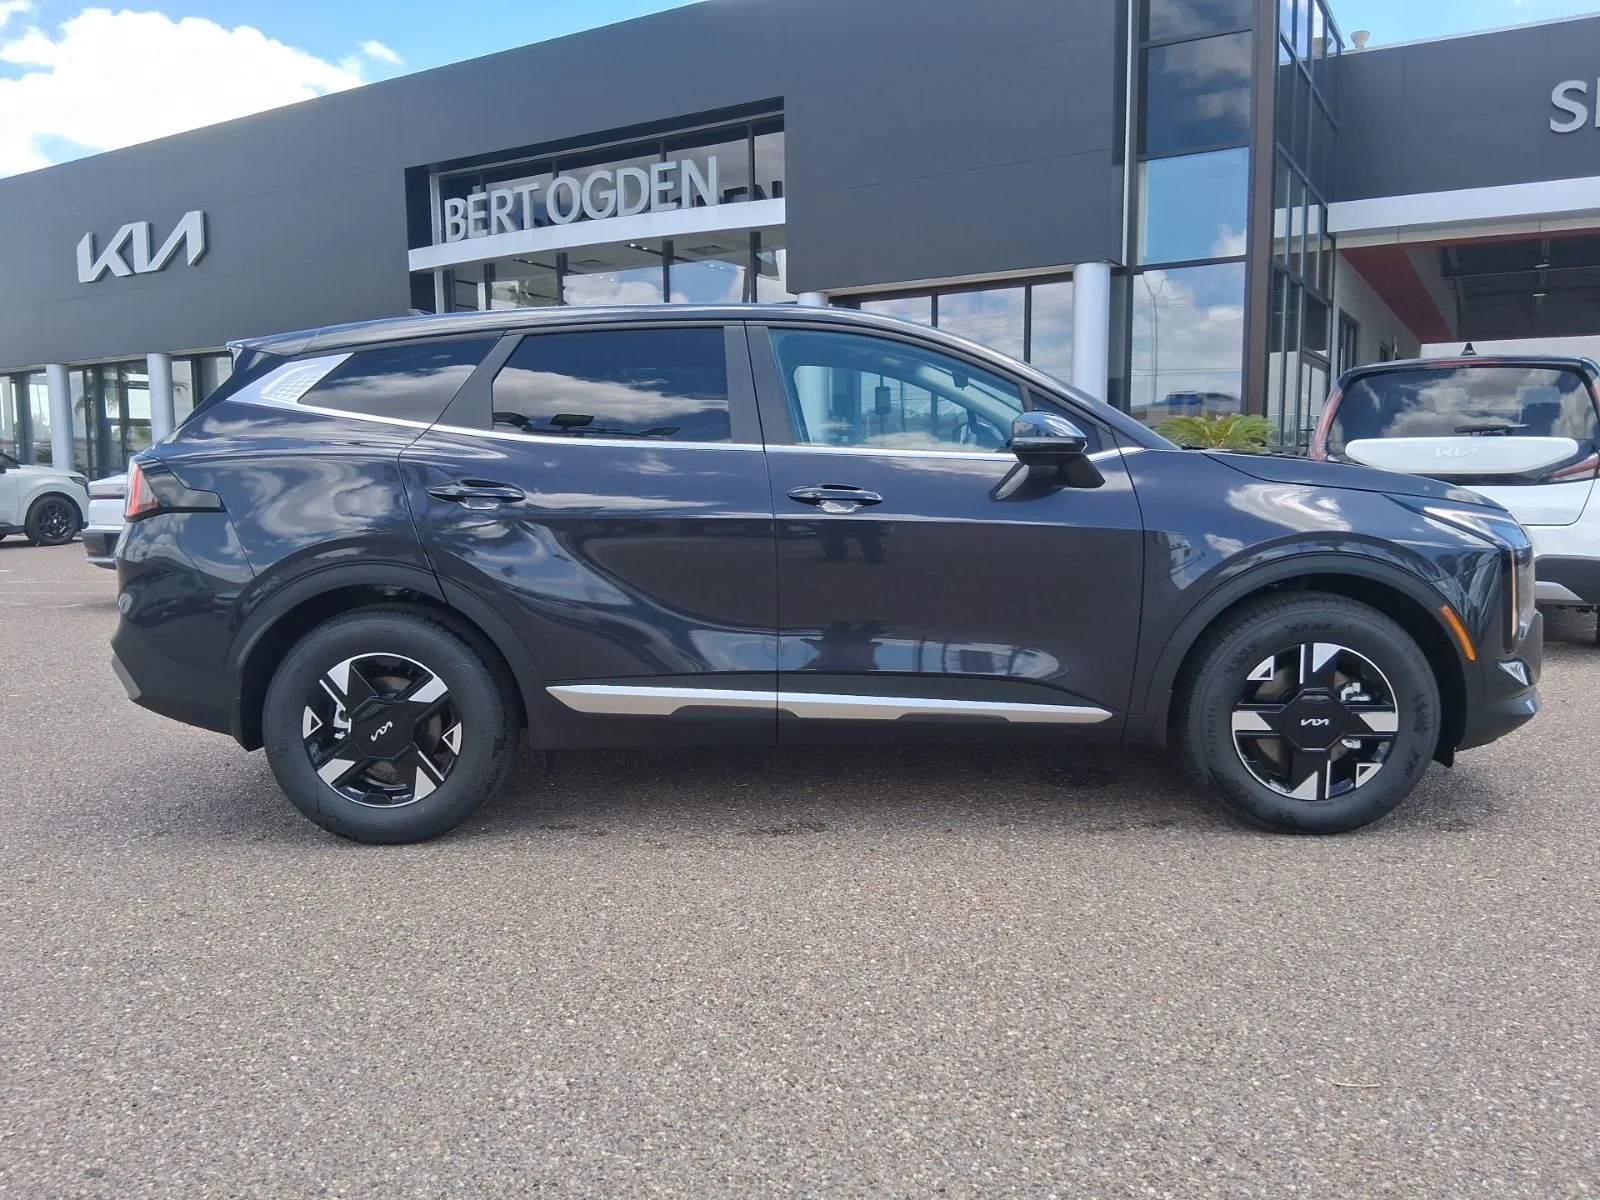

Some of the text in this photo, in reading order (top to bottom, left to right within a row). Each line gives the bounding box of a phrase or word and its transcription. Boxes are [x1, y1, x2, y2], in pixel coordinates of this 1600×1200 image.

[1549, 77, 1600, 133] S
[444, 155, 720, 243] BERT OGDEN
[76, 210, 205, 283] KIA
